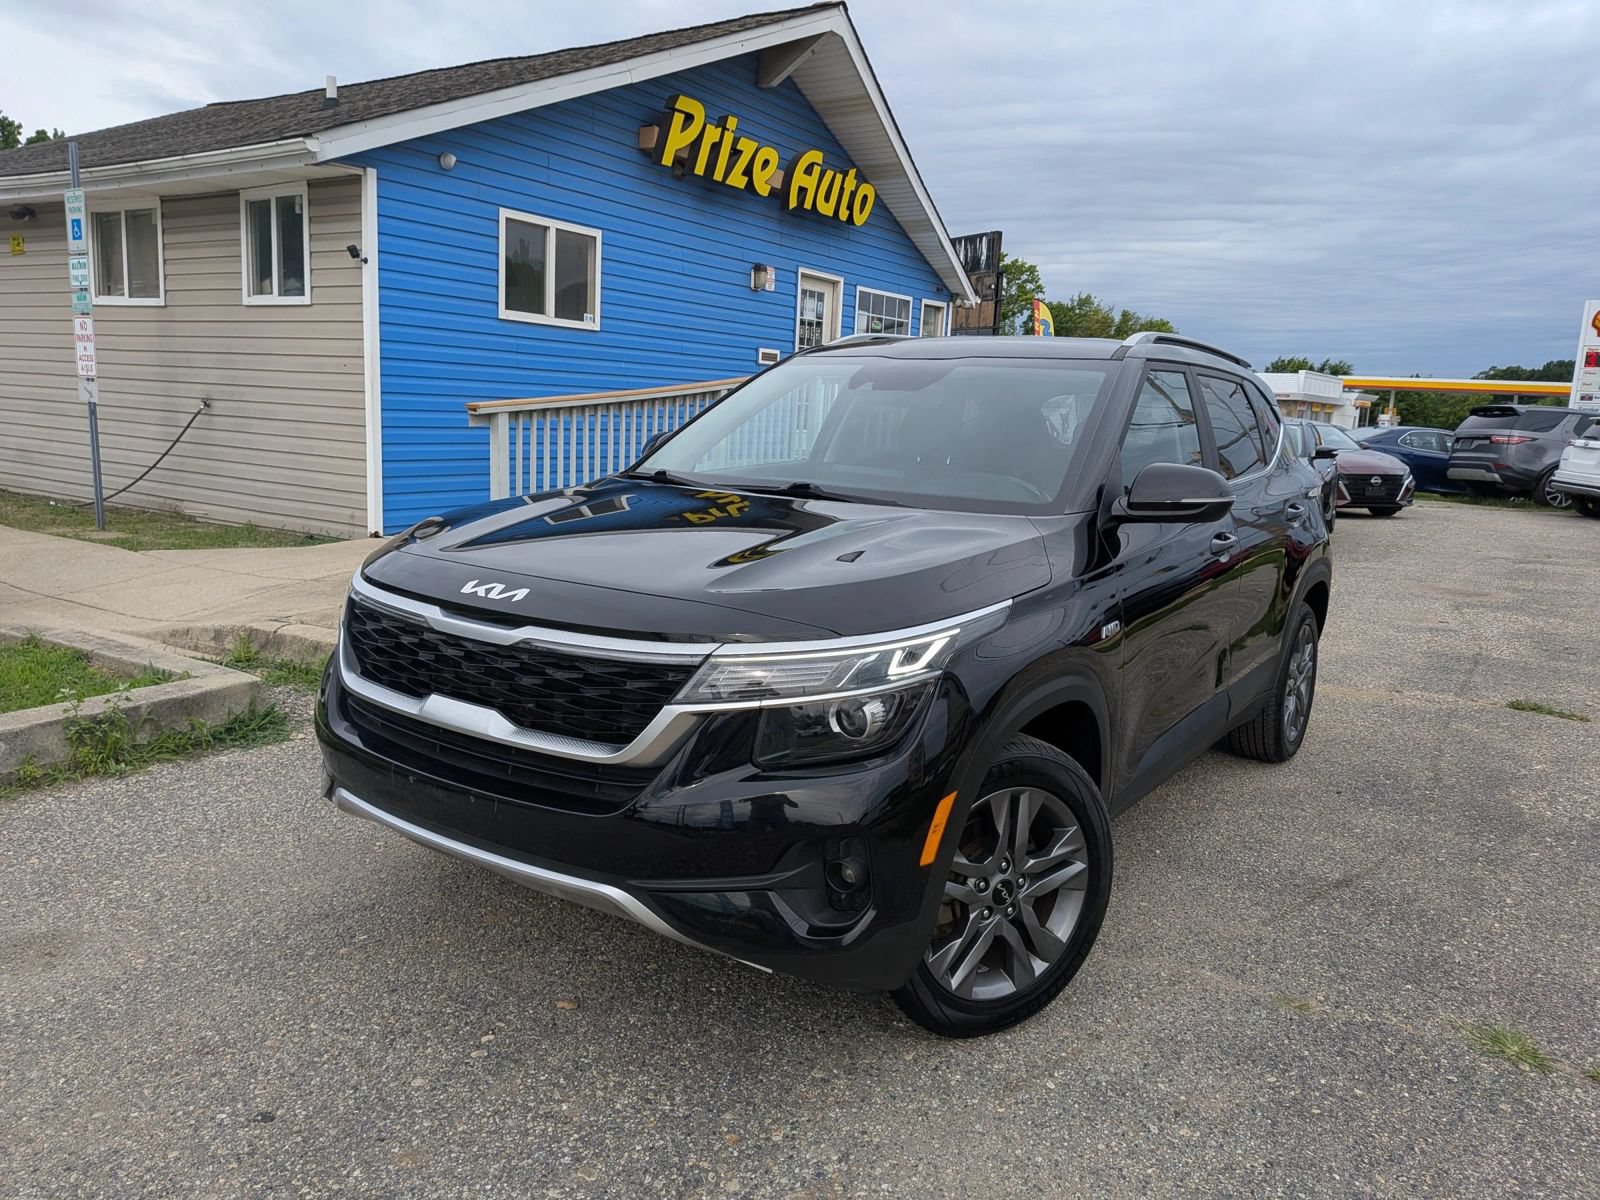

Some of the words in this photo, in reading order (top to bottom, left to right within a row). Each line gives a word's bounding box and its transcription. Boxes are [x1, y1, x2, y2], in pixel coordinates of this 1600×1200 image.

[661, 94, 780, 197] Prize
[788, 149, 876, 227] Auto
[80, 320, 88, 332] NO
[76, 334, 93, 343] PARKING
[79, 354, 94, 362] ACCESS
[81, 365, 94, 373] AISLE
[460, 579, 531, 602] KIA
